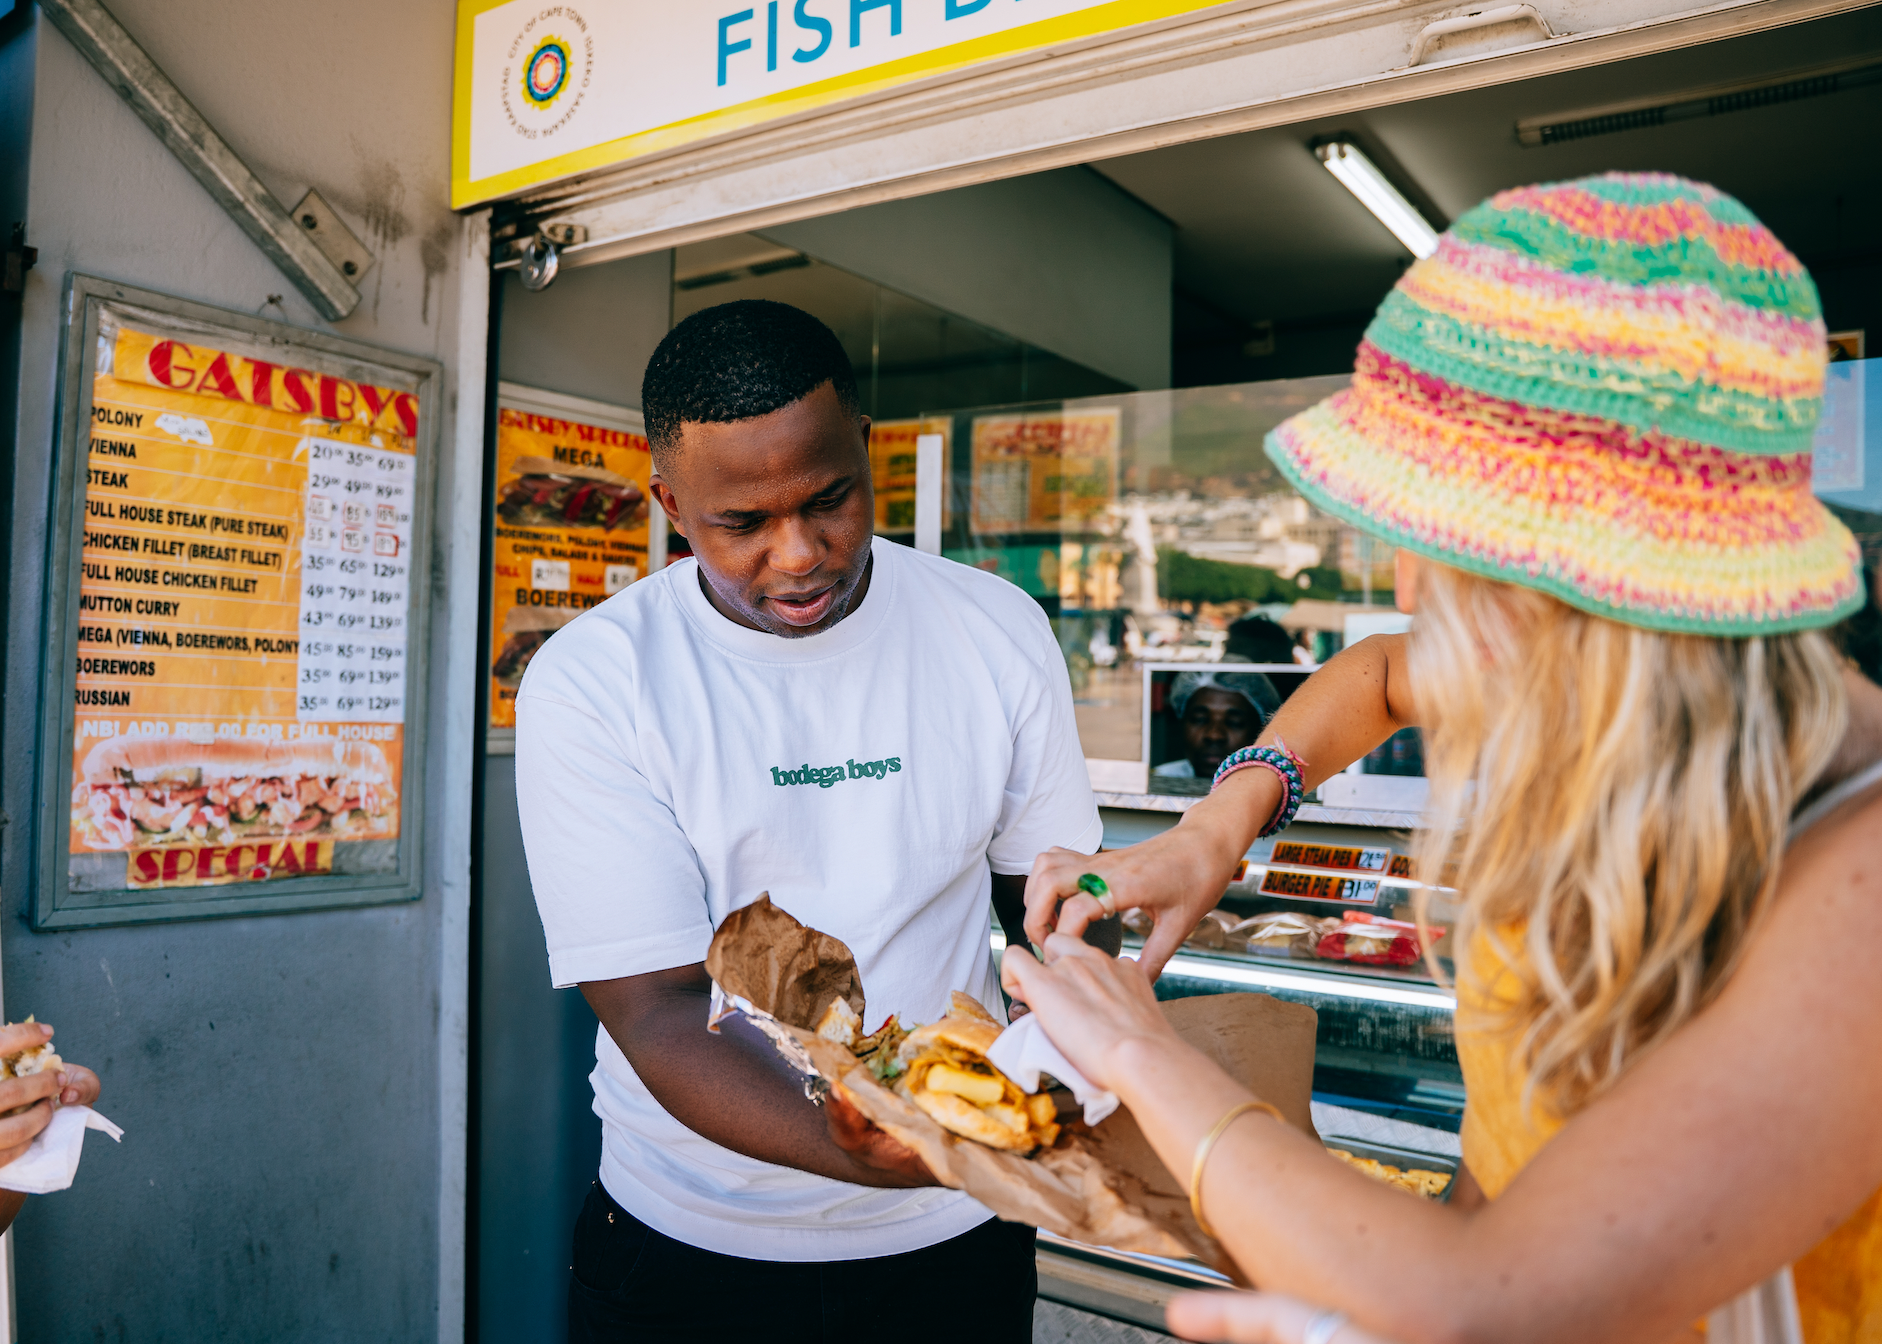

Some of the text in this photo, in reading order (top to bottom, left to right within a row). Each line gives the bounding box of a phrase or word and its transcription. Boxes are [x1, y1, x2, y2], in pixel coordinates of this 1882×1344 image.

[717, 0, 902, 87] FISH
[149, 339, 418, 437] GATSBYS
[88, 438, 137, 459] VIENNA
[553, 445, 606, 468] MEGA
[86, 469, 129, 489] STEAK
[119, 504, 163, 524] HOUSE
[167, 510, 207, 529] STEAK
[210, 516, 244, 534] (PURE
[247, 520, 289, 543] STEAK)
[83, 530, 282, 571] CHICKEN FILLET (BREAST FILLET)
[115, 566, 159, 584] HOUSE
[163, 570, 217, 590] CHICKEN
[220, 576, 258, 594] FILLET
[80, 594, 180, 616] MUTTON CURRY
[78, 626, 300, 655] MEGA (VIENNA, BOEREWORS, POLONY
[76, 657, 156, 677] BOEREWORS
[75, 689, 130, 706] RUSSIAN
[83, 720, 120, 738] NB!
[126, 721, 170, 738] ADD
[246, 723, 283, 741] FOR
[288, 724, 334, 740] FULL
[337, 725, 395, 741] HOUSE
[770, 757, 901, 788] bodega boys
[134, 841, 330, 883] SPECIAL
[1275, 843, 1302, 862] LARGE
[1306, 844, 1333, 864] STEAK
[1334, 848, 1352, 867] PIES
[1265, 872, 1310, 894] BURGER
[1313, 876, 1333, 897] PIE
